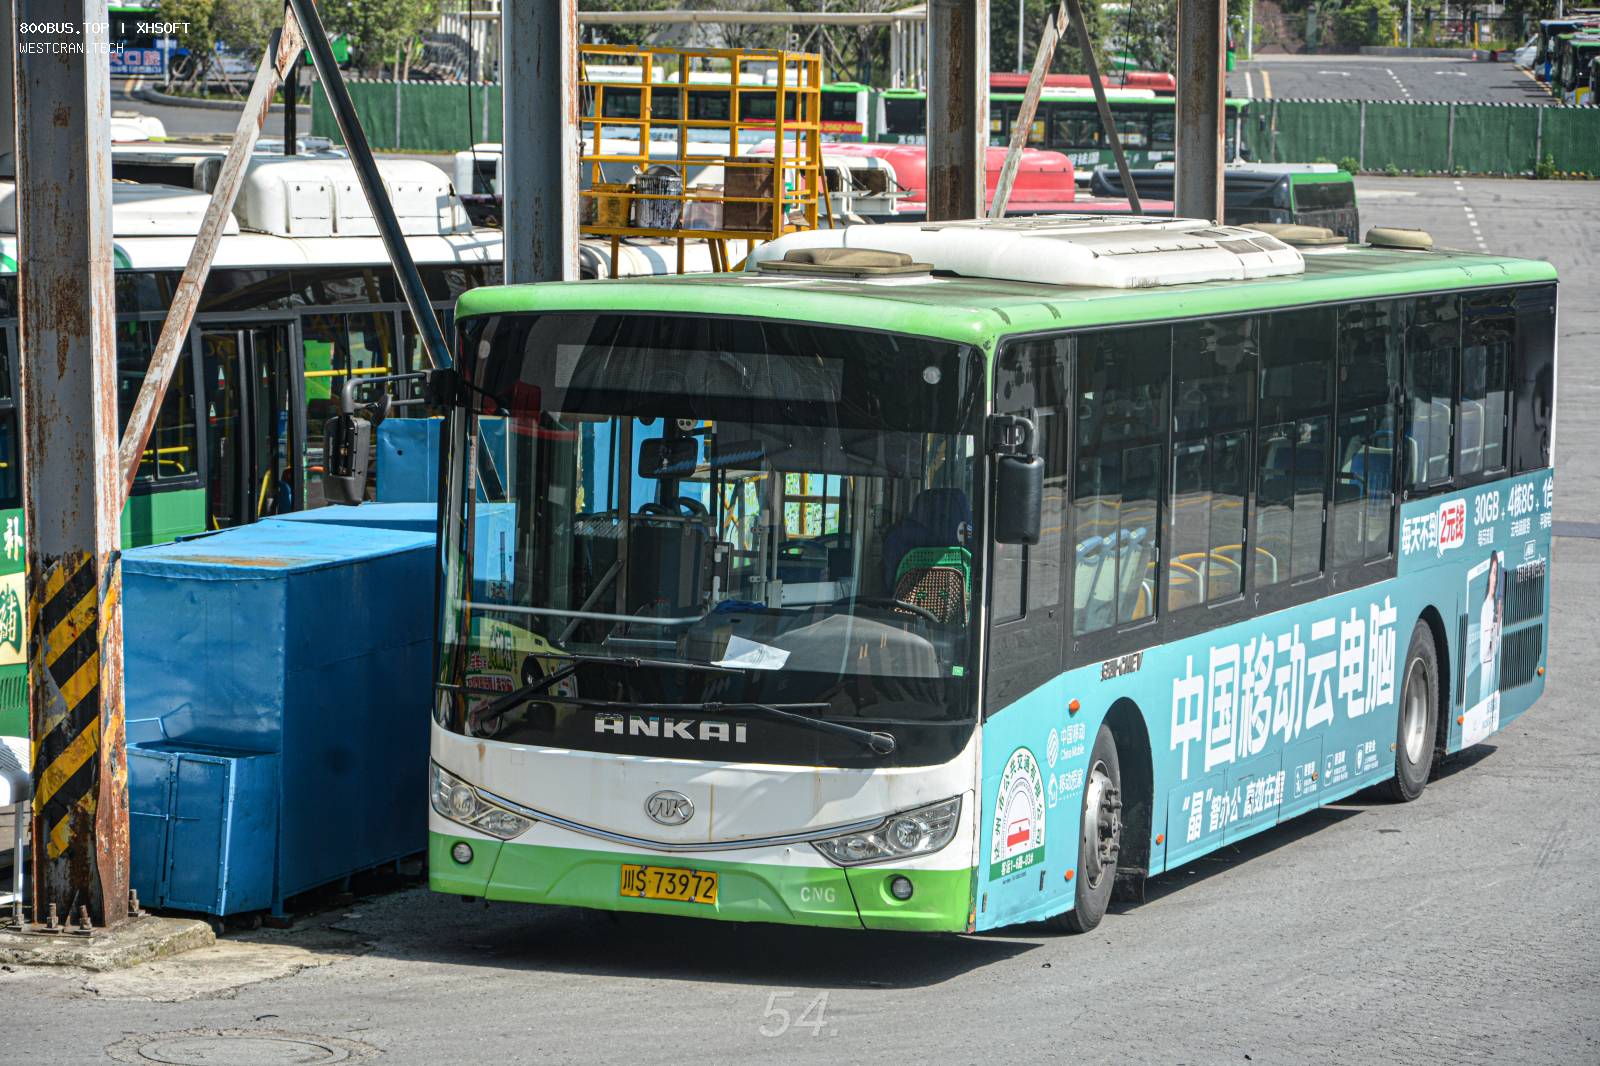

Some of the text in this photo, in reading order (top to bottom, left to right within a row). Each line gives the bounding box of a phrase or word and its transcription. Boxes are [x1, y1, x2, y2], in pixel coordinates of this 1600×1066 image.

[1474, 490, 1500, 526] 30GB
[1507, 482, 1535, 517] 4核8G
[1401, 503, 1465, 556] 每天不到 2元钱
[1169, 595, 1398, 781] 中国移动云电脑
[594, 713, 747, 743] ANKAI
[1060, 722, 1086, 747] 中国移动
[1243, 770, 1286, 818] 高效在握
[800, 886, 836, 903] CNG
